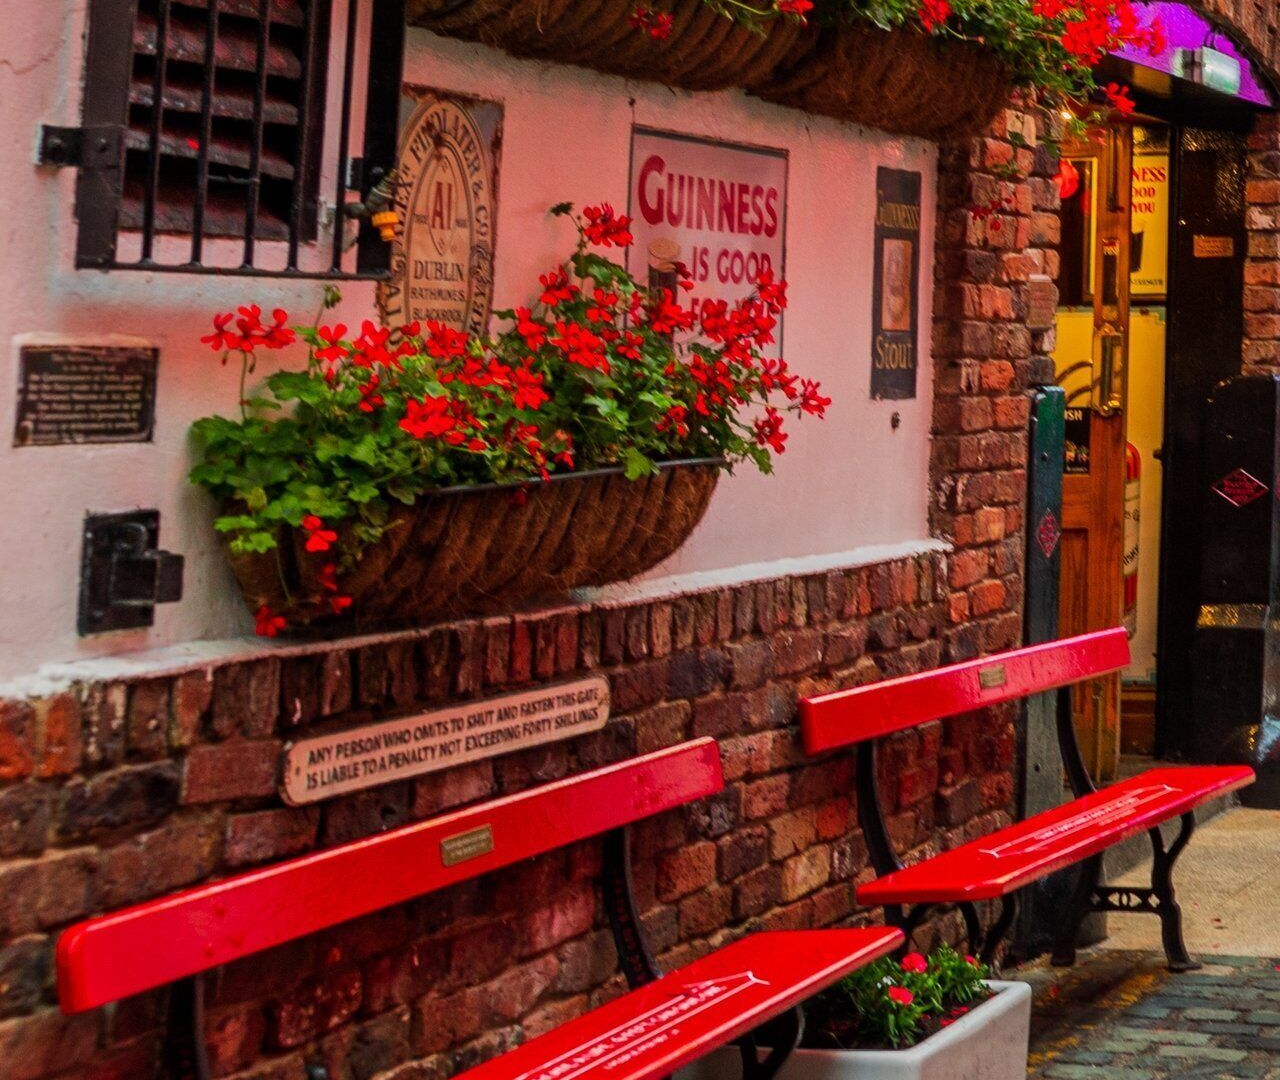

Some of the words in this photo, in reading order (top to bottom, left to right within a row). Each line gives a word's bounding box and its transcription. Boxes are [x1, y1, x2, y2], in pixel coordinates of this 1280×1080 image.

[637, 154, 778, 239] GUINNESS
[413, 260, 465, 282] DUBLIN
[692, 246, 709, 282] IS
[717, 247, 772, 285] GOOD
[876, 335, 913, 370] Stout
[307, 771, 318, 790] IS
[321, 762, 359, 786] LIABLE
[361, 758, 377, 775] TO
[378, 756, 387, 770] A
[387, 745, 438, 768] PENALTY
[439, 738, 461, 758] NOT
[464, 724, 521, 752] EXCEEDING
[523, 717, 553, 738] FORTY
[555, 707, 599, 730] SHILLINGS
[308, 746, 333, 766] ANY
[335, 735, 381, 759] PERSON
[383, 729, 411, 748] WHO
[413, 720, 448, 741] OMITS
[450, 717, 464, 733] TO
[467, 709, 494, 729] SHUT
[497, 705, 518, 722] AND
[520, 697, 553, 716] FASTEN
[556, 691, 576, 707] THIS
[577, 687, 600, 704] GATE
